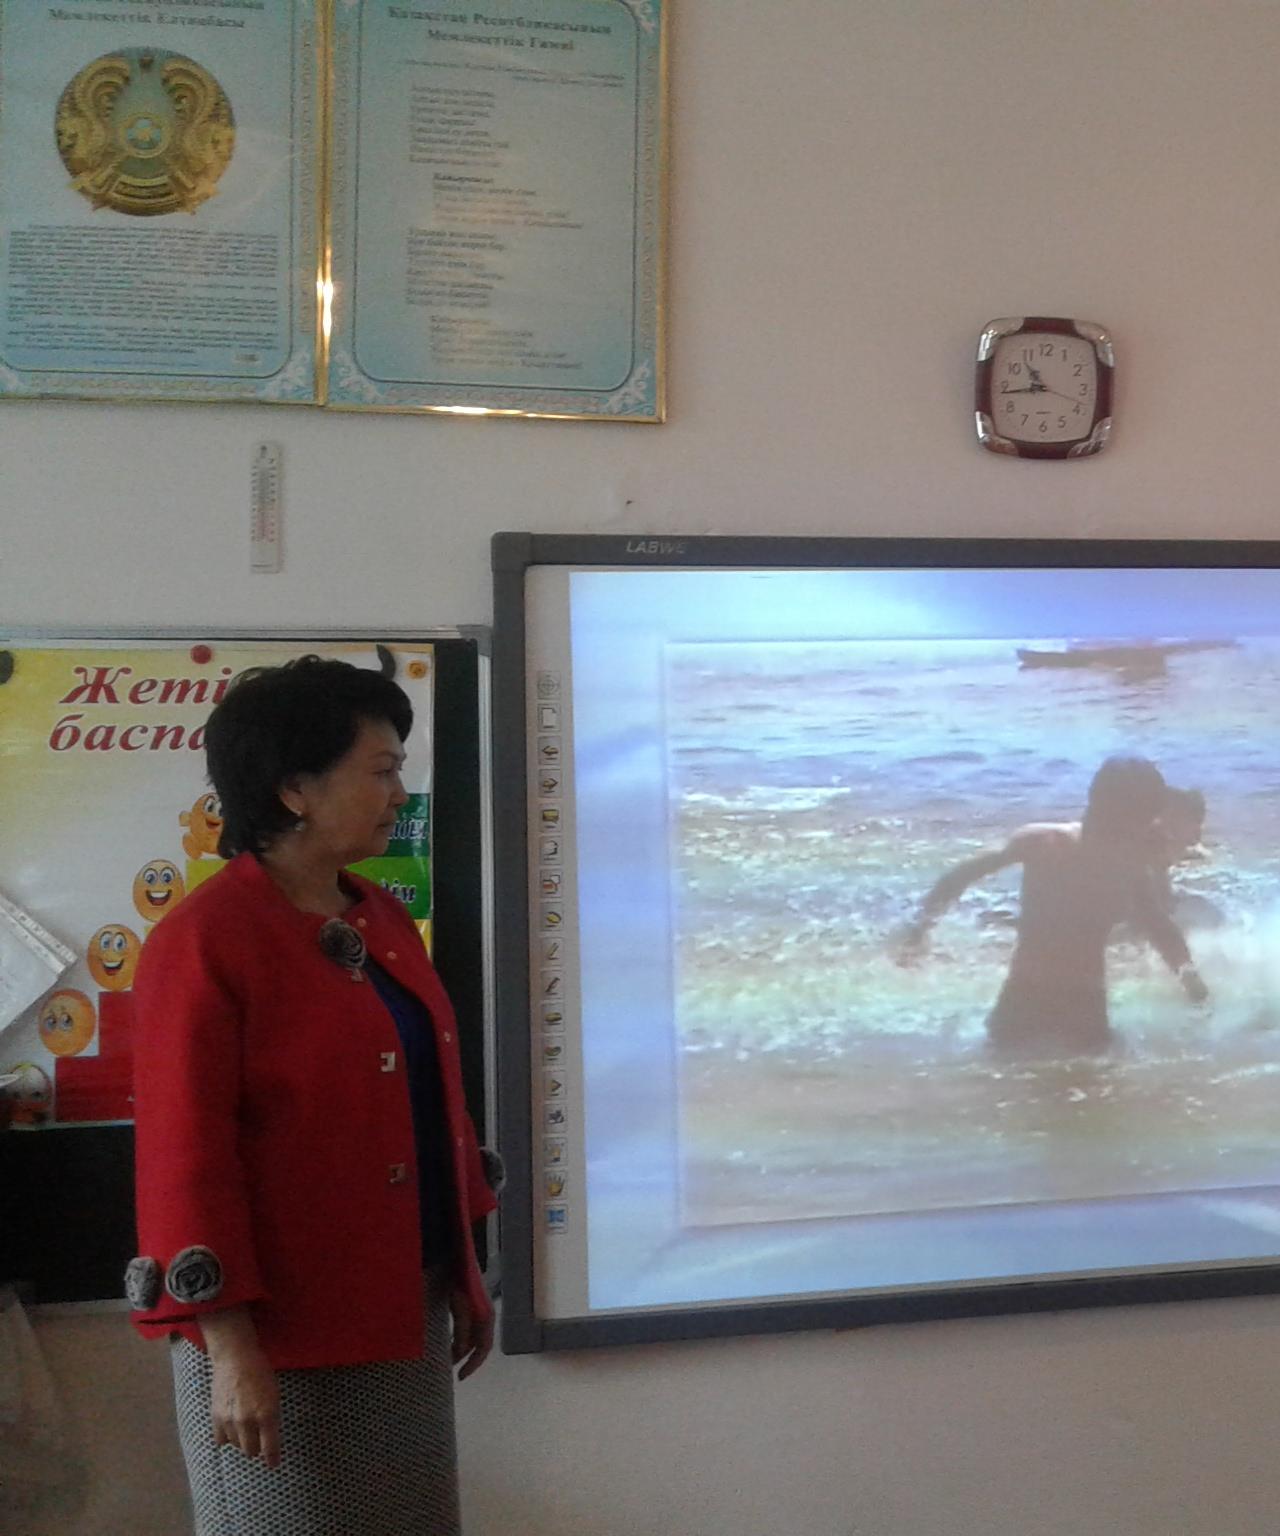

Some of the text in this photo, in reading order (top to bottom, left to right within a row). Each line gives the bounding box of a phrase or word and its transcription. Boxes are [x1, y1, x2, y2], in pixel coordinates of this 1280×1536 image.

[1023, 349, 1033, 361] 11
[1039, 344, 1054, 356] 12
[1062, 349, 1067, 360] 1
[1008, 363, 1021, 374] 10
[1074, 365, 1082, 376] 2
[1079, 384, 1088, 395] 3
[1006, 402, 1015, 412] 8
[1072, 404, 1082, 414] 4
[1021, 415, 1028, 426] 7
[1058, 416, 1066, 427] 5
[1039, 422, 1047, 432] 6
